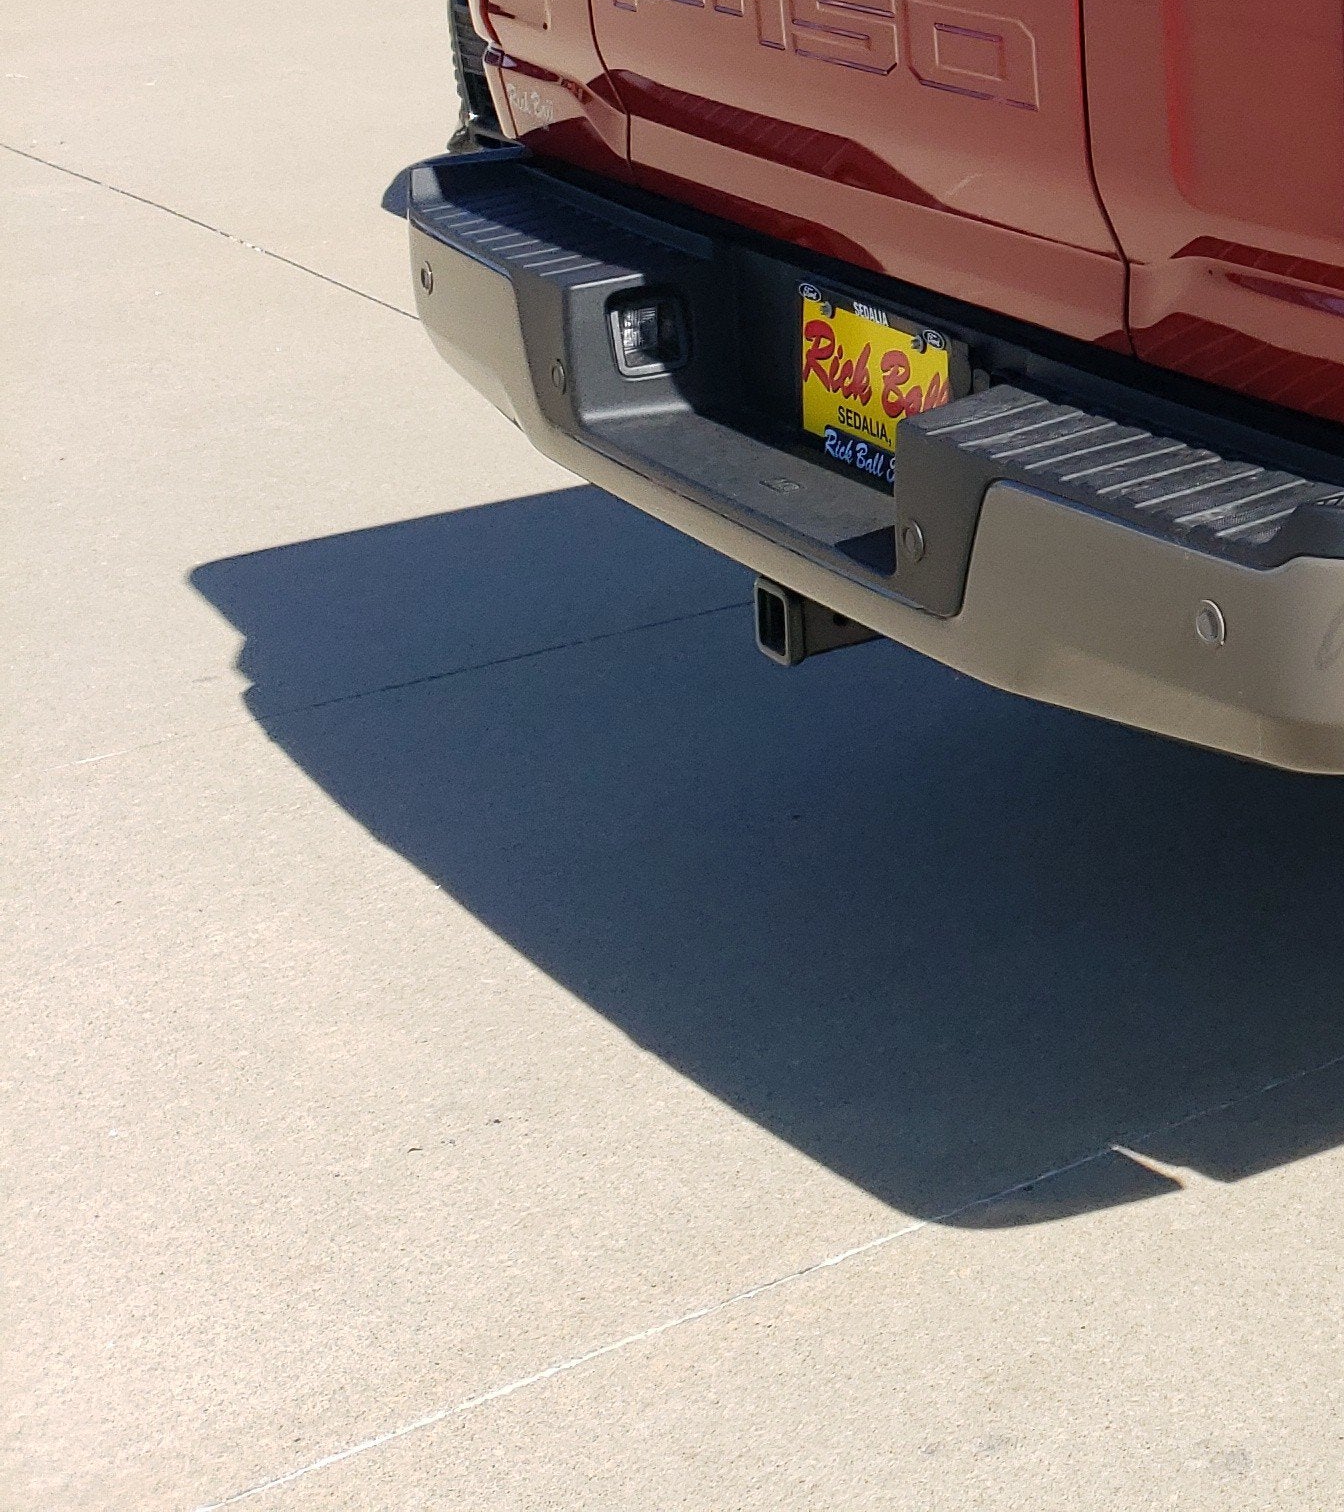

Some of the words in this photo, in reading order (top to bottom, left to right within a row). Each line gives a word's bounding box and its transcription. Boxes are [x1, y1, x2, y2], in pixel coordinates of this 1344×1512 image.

[853, 301, 890, 327] SEDALIA
[803, 319, 872, 407] Rick
[838, 405, 893, 447] SEDALIA,
[824, 428, 853, 466] Rick
[855, 443, 885, 477] Ball
